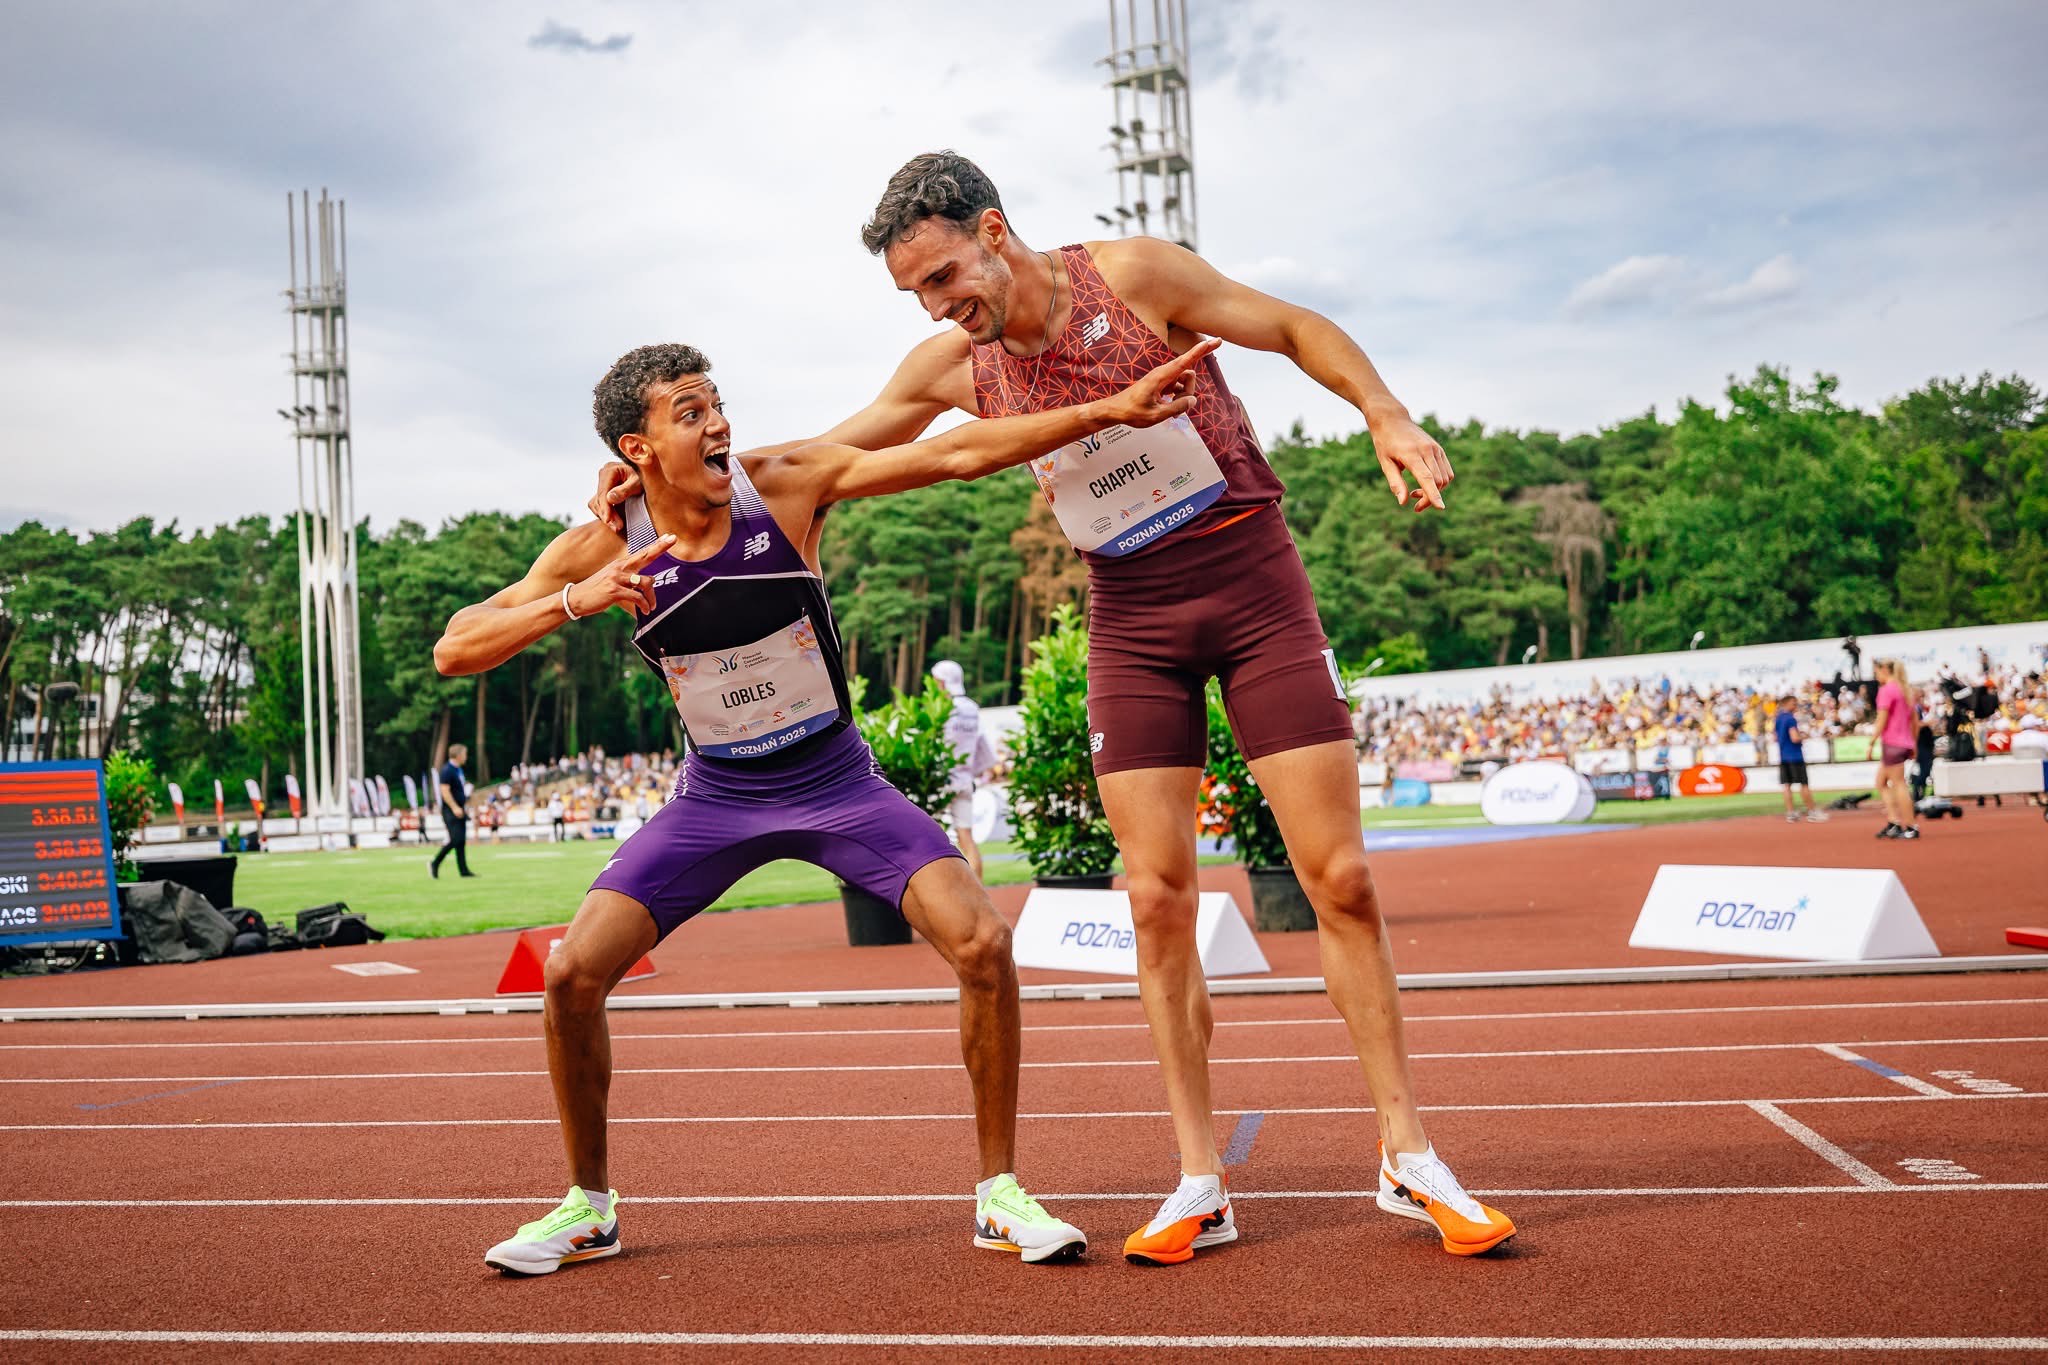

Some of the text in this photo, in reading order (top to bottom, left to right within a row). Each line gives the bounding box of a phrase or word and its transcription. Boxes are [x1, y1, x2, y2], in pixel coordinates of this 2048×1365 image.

[1089, 454, 1154, 499] CHAPPLE
[1118, 519, 1166, 551] POZNAŃ
[1165, 504, 1194, 526] 2025
[721, 681, 776, 709] LOBLES
[730, 726, 807, 756] POZNAŃ 2025
[1696, 902, 1796, 931] POZnan
